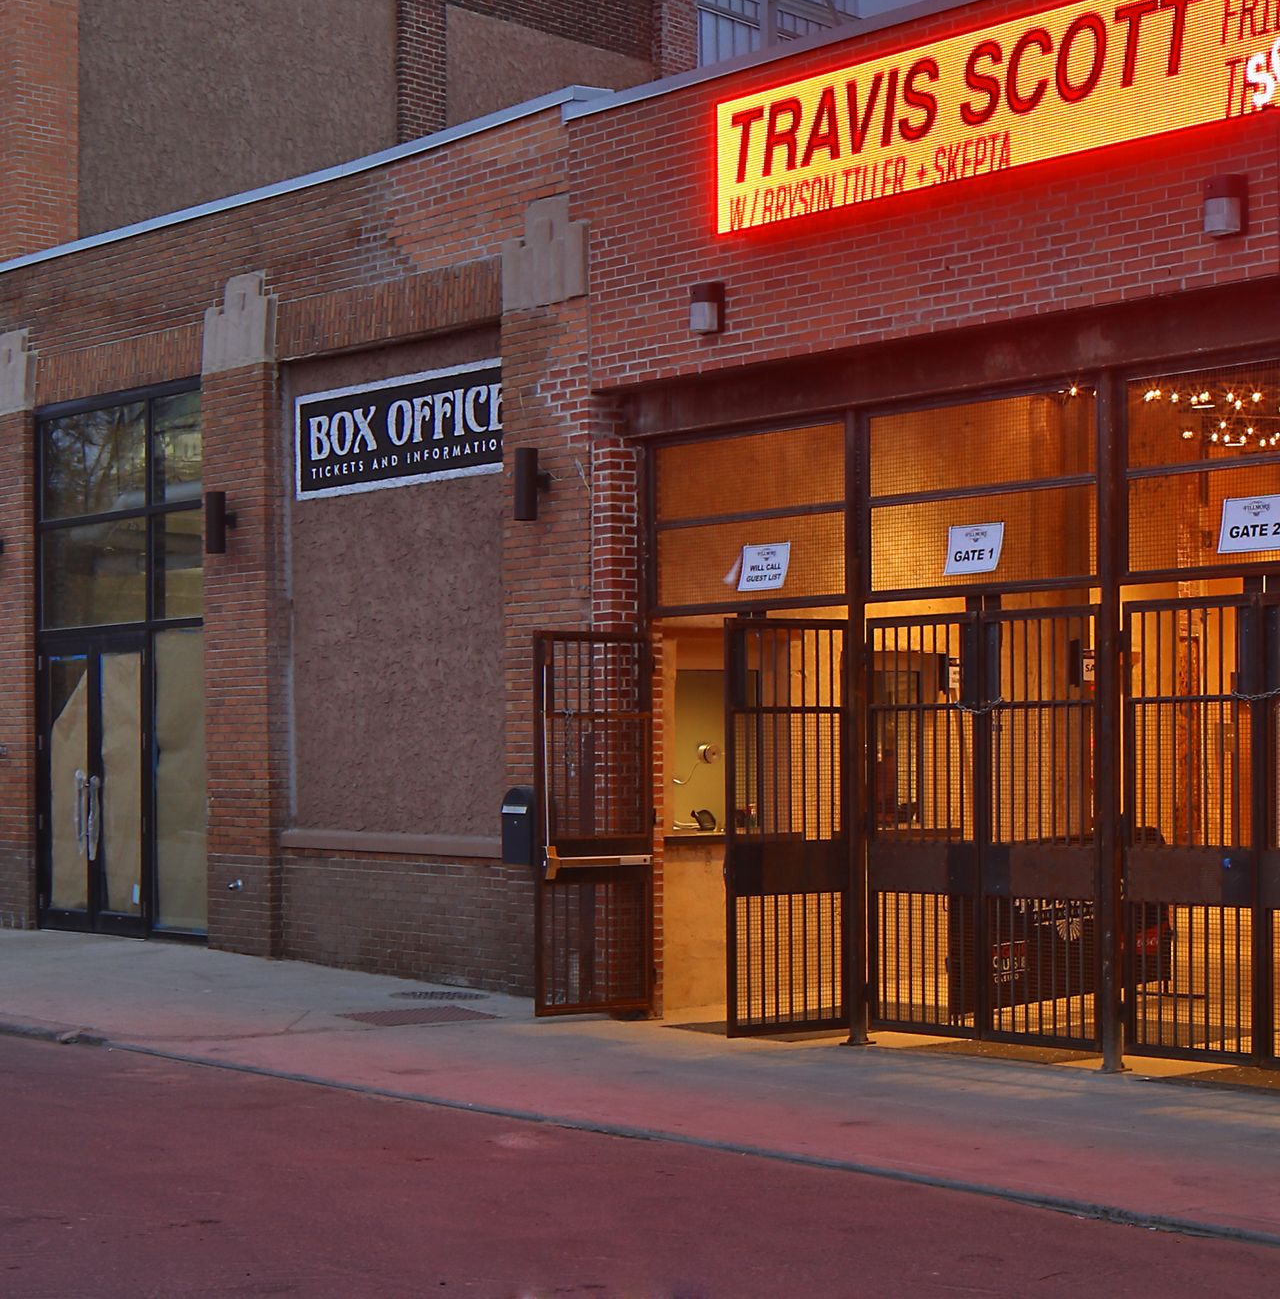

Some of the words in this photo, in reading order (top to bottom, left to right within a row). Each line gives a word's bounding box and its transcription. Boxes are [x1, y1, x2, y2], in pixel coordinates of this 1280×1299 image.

[730, 57, 939, 184] TRAVIS
[762, 170, 836, 224] BRYSON
[841, 155, 907, 206] TILLER
[916, 163, 928, 184] +
[932, 130, 1011, 185] SKEPTA
[308, 404, 378, 461] BOX
[387, 381, 503, 447] OFFICE
[311, 460, 365, 480] TICKETS
[372, 454, 399, 471] AND
[407, 439, 504, 465] INFORMATIO
[1229, 523, 1269, 539] GATE
[1272, 522, 1280, 536] 2
[749, 564, 764, 572] WILL
[766, 563, 782, 571] CALL
[954, 548, 985, 563] GATE
[988, 547, 994, 560] 1
[746, 574, 767, 583] GUEST
[768, 573, 782, 581] LIST
